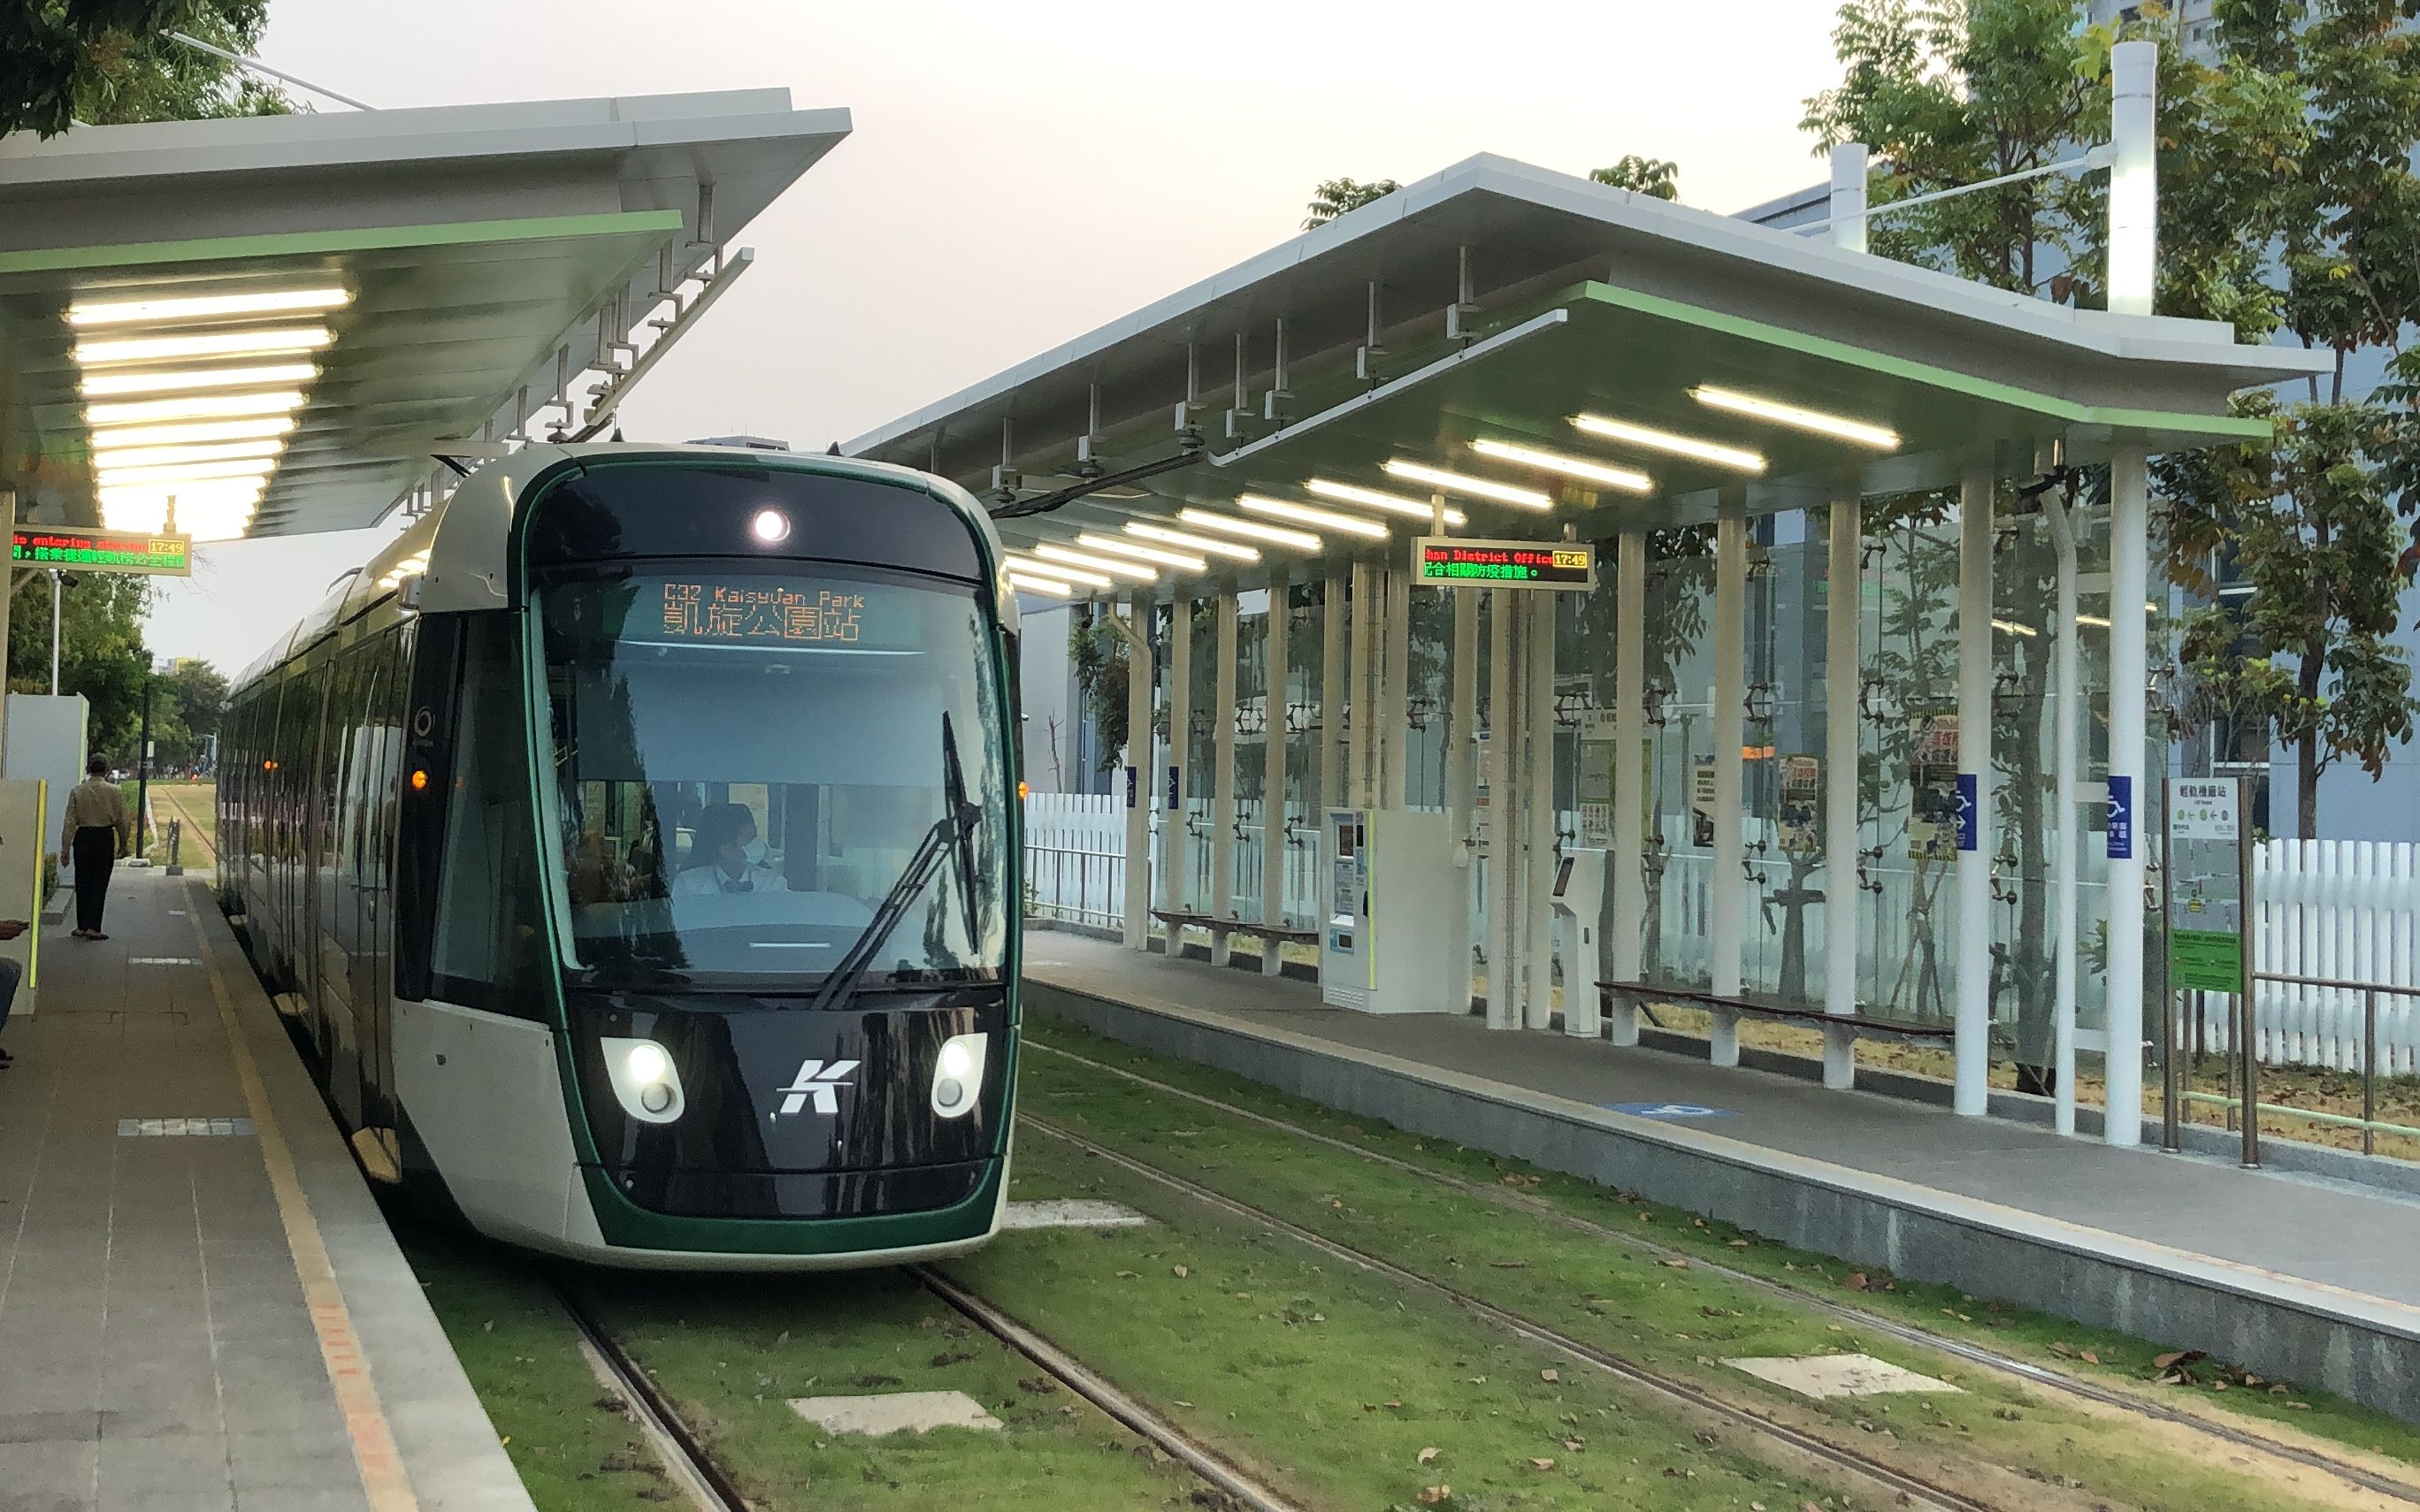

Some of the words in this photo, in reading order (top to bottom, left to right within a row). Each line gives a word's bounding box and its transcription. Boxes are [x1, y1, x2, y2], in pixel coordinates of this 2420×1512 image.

[32, 536, 91, 548] entering
[150, 542, 183, 553] 17:49
[1453, 549, 1509, 562] District
[1555, 554, 1585, 565] 17:49
[664, 583, 701, 601] C32
[715, 585, 806, 606] Kaisyuan
[819, 591, 865, 608] Park
[664, 601, 862, 641] 凱旋公園站
